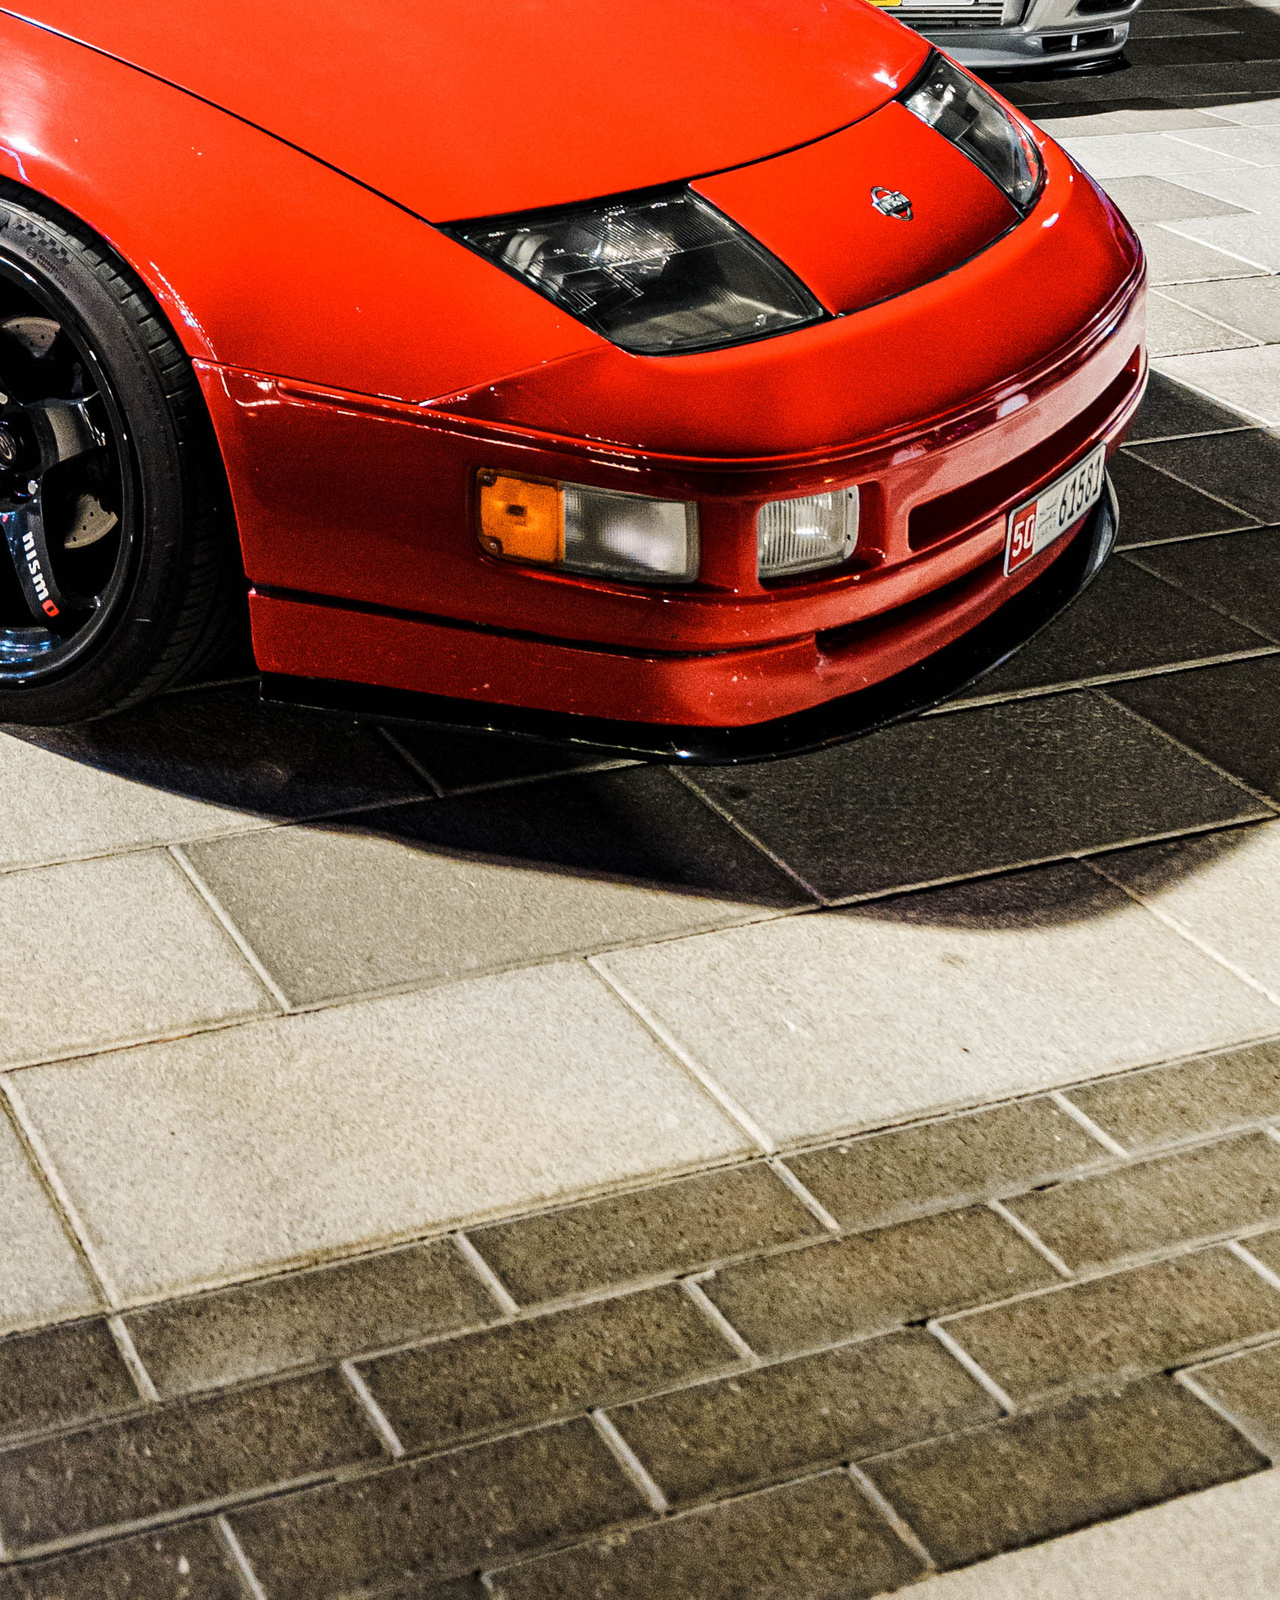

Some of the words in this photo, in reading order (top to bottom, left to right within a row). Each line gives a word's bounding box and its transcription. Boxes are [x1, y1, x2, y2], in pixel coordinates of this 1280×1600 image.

[1059, 455, 1101, 527] 61581
[1011, 513, 1036, 558] 50
[22, 531, 60, 617] nismo
